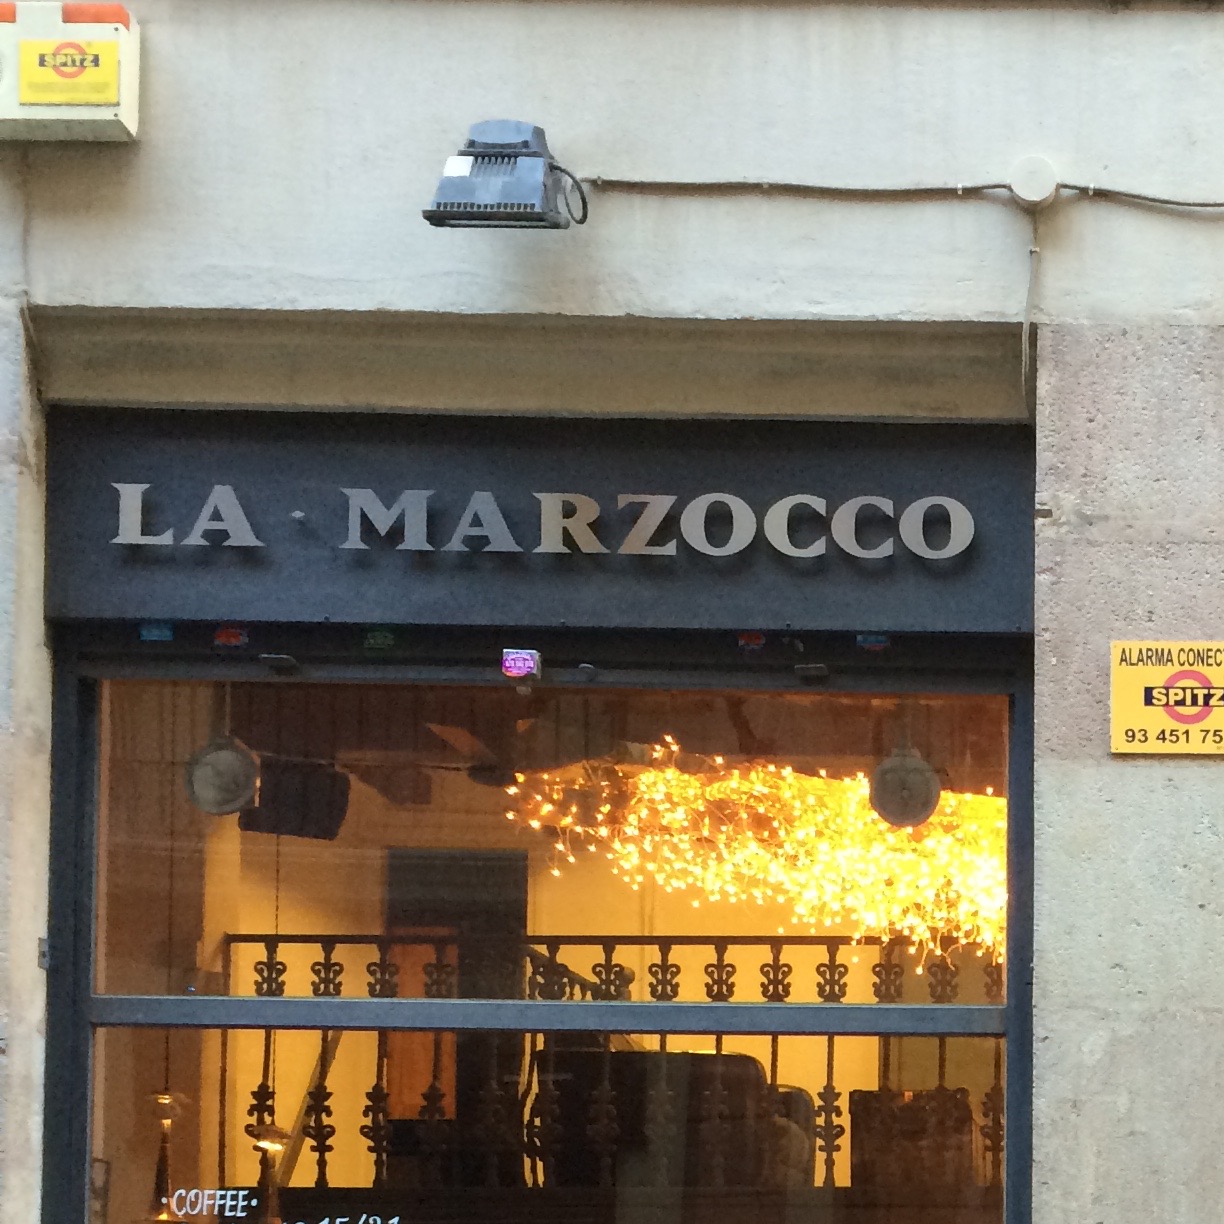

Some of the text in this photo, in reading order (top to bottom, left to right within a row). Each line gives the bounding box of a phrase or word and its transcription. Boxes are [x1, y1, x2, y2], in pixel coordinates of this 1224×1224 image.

[44, 54, 95, 67] SPITZ
[110, 482, 976, 560] LA MARZOCCO
[1119, 647, 1174, 666] ALARMA
[1151, 688, 1224, 706] SPITZ
[1124, 728, 1149, 743] 93
[1155, 729, 1190, 744] 451
[1200, 729, 1224, 744] 75
